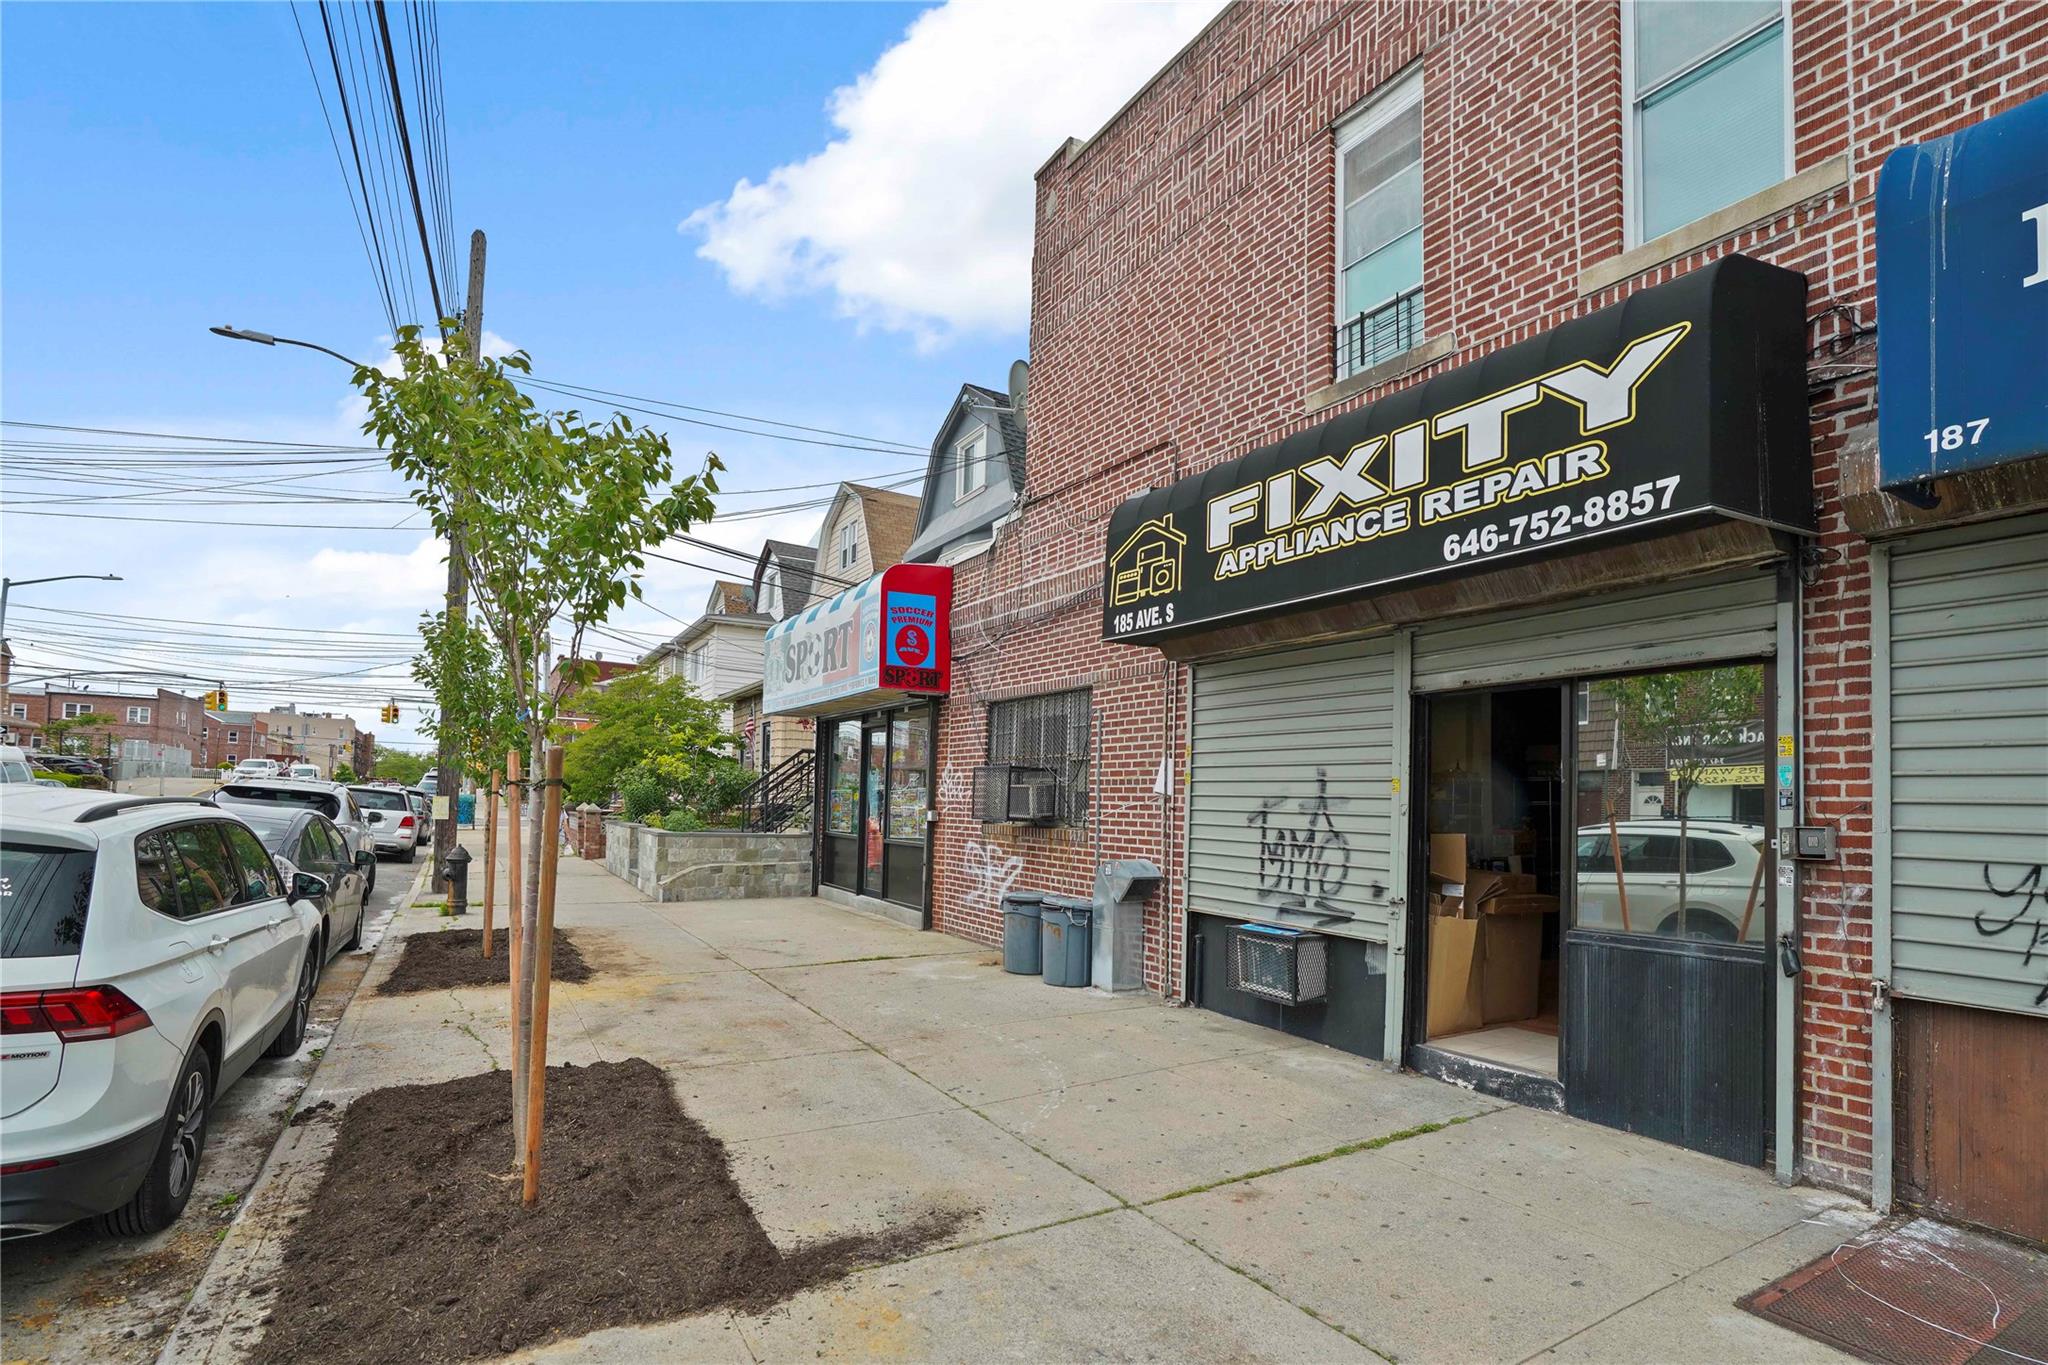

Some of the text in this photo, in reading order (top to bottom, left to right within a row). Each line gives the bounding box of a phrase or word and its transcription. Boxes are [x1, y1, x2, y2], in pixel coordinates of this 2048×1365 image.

[1208, 323, 1690, 551] FIXITY
[1923, 417, 1990, 453] 187
[1216, 443, 1606, 578] APPLIANCE REPAIR
[1443, 475, 1681, 561] 646-752-8857
[890, 607, 934, 618] SOCCER
[891, 616, 933, 628] PREMIUM
[1114, 602, 1174, 634] 185 AVE. S
[907, 630, 917, 646] S
